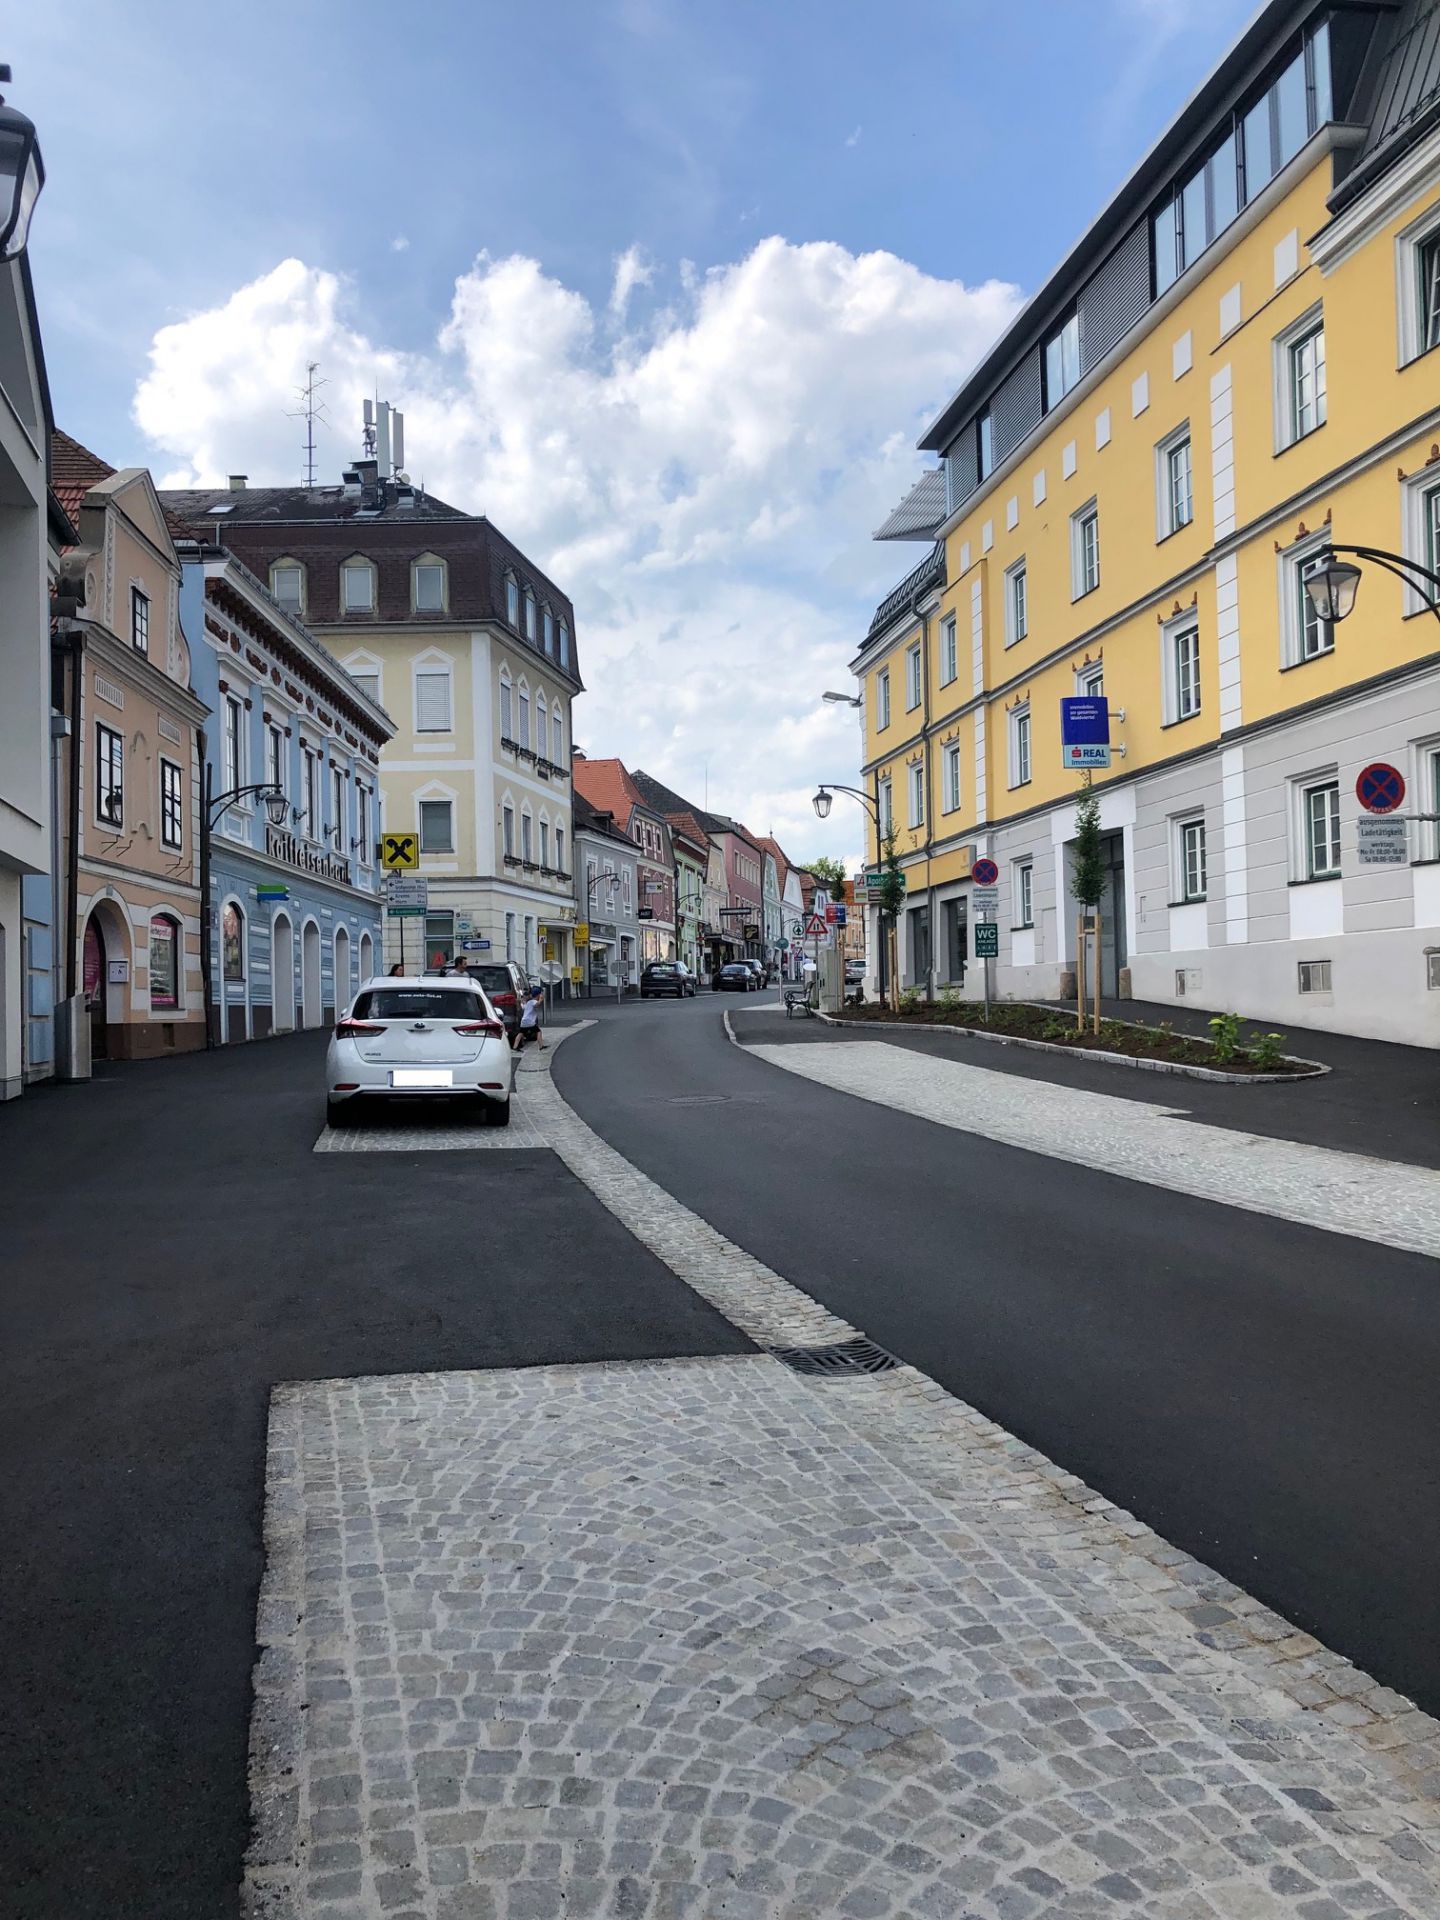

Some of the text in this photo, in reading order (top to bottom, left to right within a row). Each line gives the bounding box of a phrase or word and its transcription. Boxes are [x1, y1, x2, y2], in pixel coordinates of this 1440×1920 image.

[1083, 749, 1107, 757] REAL
[1359, 819, 1404, 827] ausgenommen
[1361, 828, 1403, 837] Ladetätigkeit
[977, 929, 996, 939] WC
